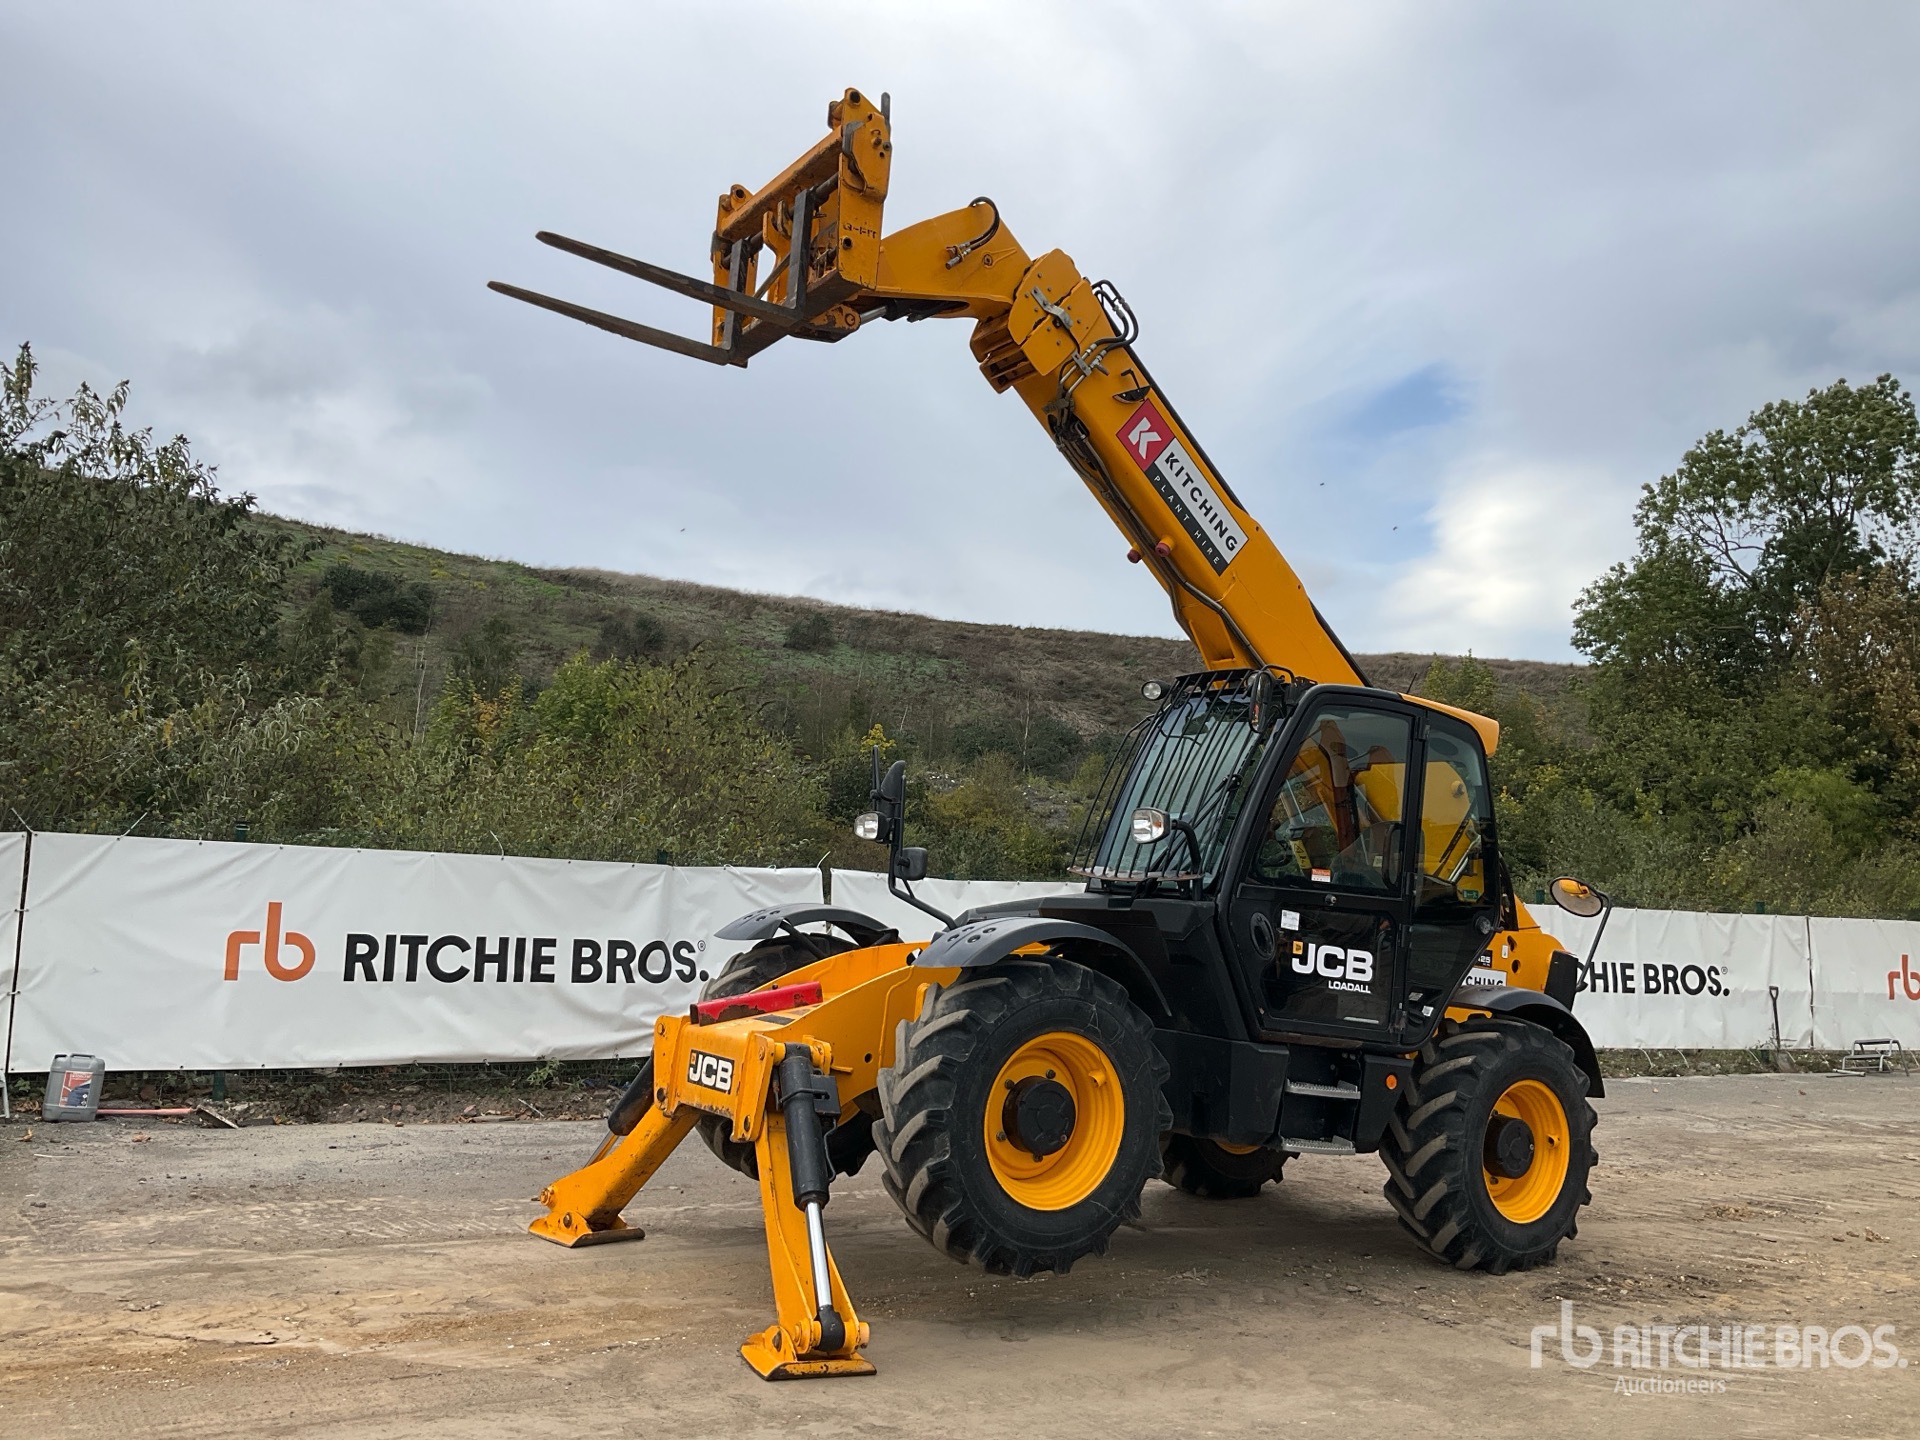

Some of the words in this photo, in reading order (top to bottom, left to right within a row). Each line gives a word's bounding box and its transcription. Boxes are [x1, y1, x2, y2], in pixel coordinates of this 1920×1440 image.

[1153, 475, 1190, 521] PLANT
[1194, 529, 1220, 565] HIRE
[1164, 452, 1238, 552] KITCHING
[224, 902, 316, 981] rb
[344, 934, 557, 984] RITCHIE
[1291, 942, 1374, 982] JCB
[1328, 980, 1372, 994] LOADALL
[689, 1053, 733, 1091] JCB
